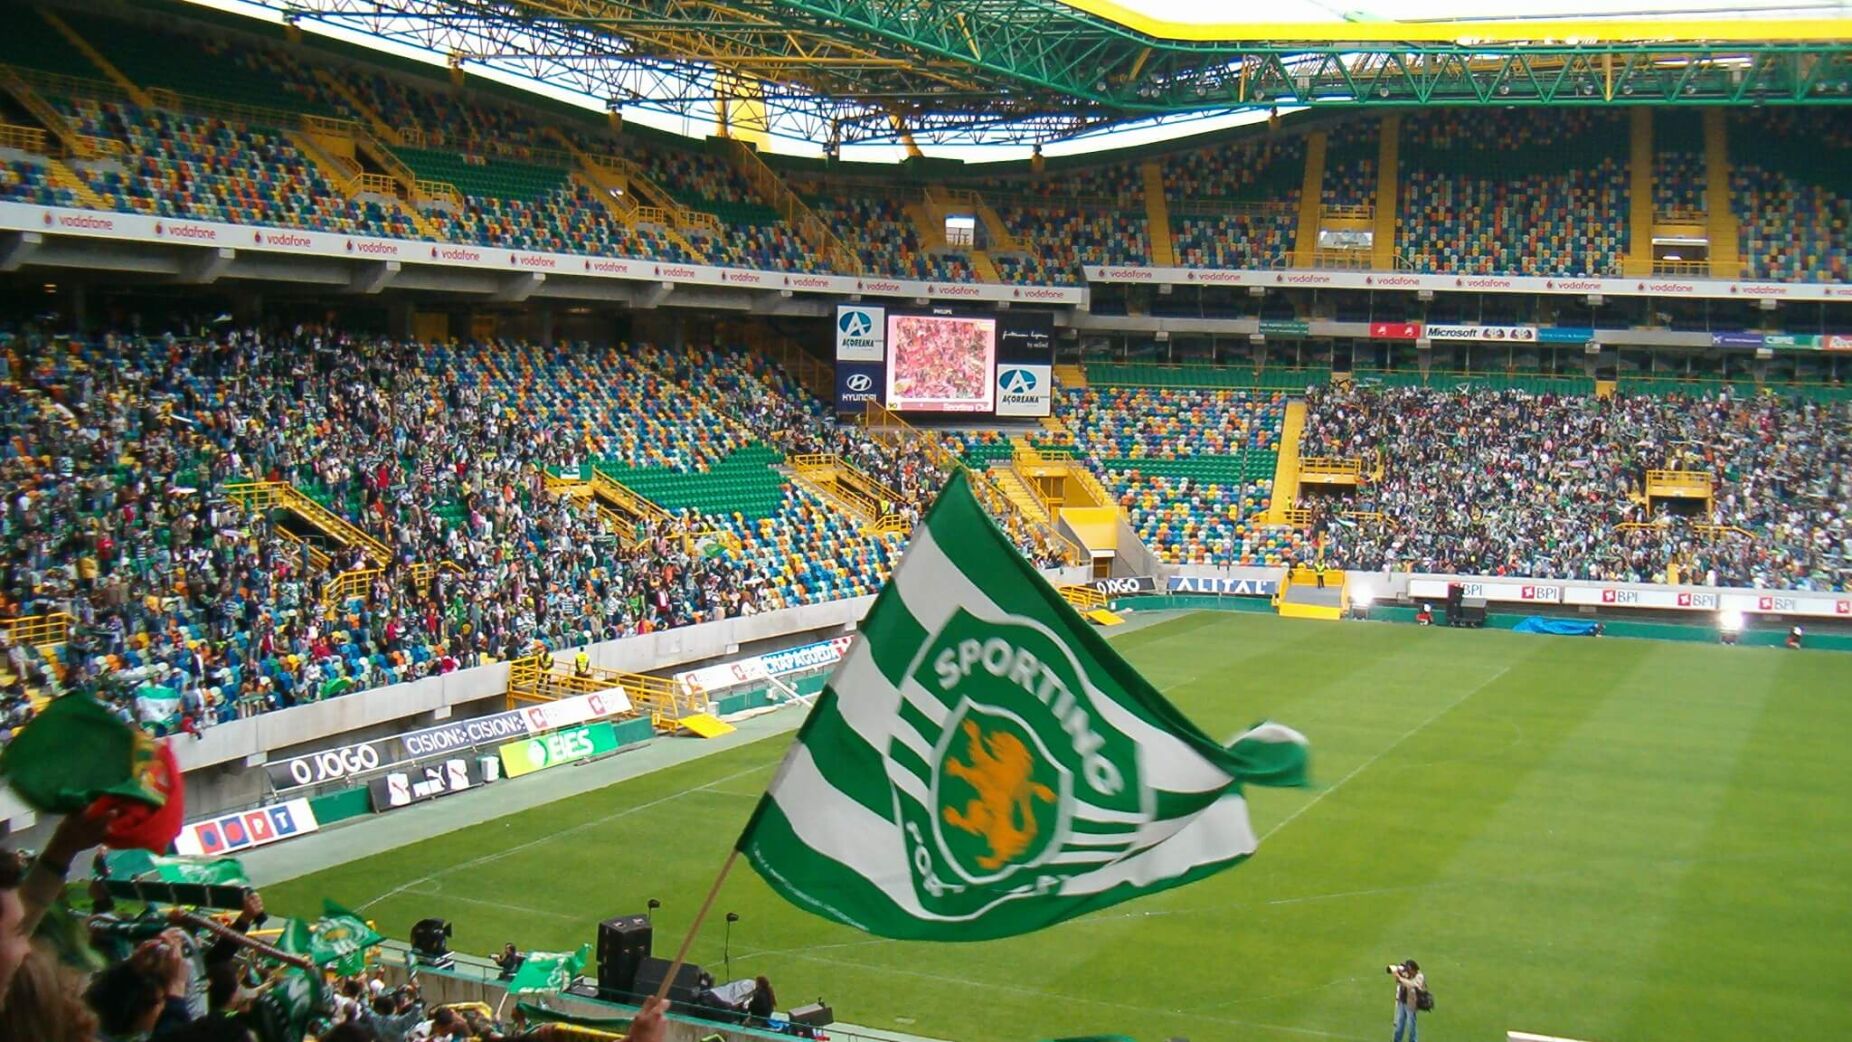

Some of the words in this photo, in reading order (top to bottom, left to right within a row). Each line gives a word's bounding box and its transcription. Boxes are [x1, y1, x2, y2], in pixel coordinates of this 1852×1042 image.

[59, 214, 113, 231] vodafone
[168, 225, 216, 240] vodafone
[266, 234, 311, 248] vodafone
[357, 242, 398, 255] vodafone
[441, 249, 480, 262] vodafone
[519, 255, 556, 268] vodafone
[593, 262, 628, 274] vodafone
[662, 267, 695, 279] vodafone
[729, 272, 760, 283] vodafone
[1110, 270, 1153, 280] vodafone
[1199, 272, 1241, 282] vodafone
[1287, 274, 1330, 284] vodafone
[1376, 276, 1420, 286] vodafone
[791, 277, 830, 288] vodafone
[865, 282, 899, 293] vodafone
[1467, 278, 1511, 289] vodafone
[1557, 280, 1601, 290] vodafone
[1649, 282, 1693, 293] vodafone
[938, 285, 980, 296] vodafone
[1024, 288, 1064, 299] vodafone
[1741, 285, 1787, 295] vodafone
[1427, 327, 1477, 338] Microsoft
[1001, 394, 1039, 405] AÇOREANA
[1535, 586, 1557, 600] BPI
[1617, 590, 1638, 603] BPI
[1692, 594, 1714, 607] BPI
[1774, 598, 1796, 611] BPI
[932, 636, 1126, 796] SPORTING
[467, 716, 517, 741] CISION
[406, 729, 459, 756] CISION
[289, 759, 312, 785] O
[316, 743, 380, 781] JOGO
